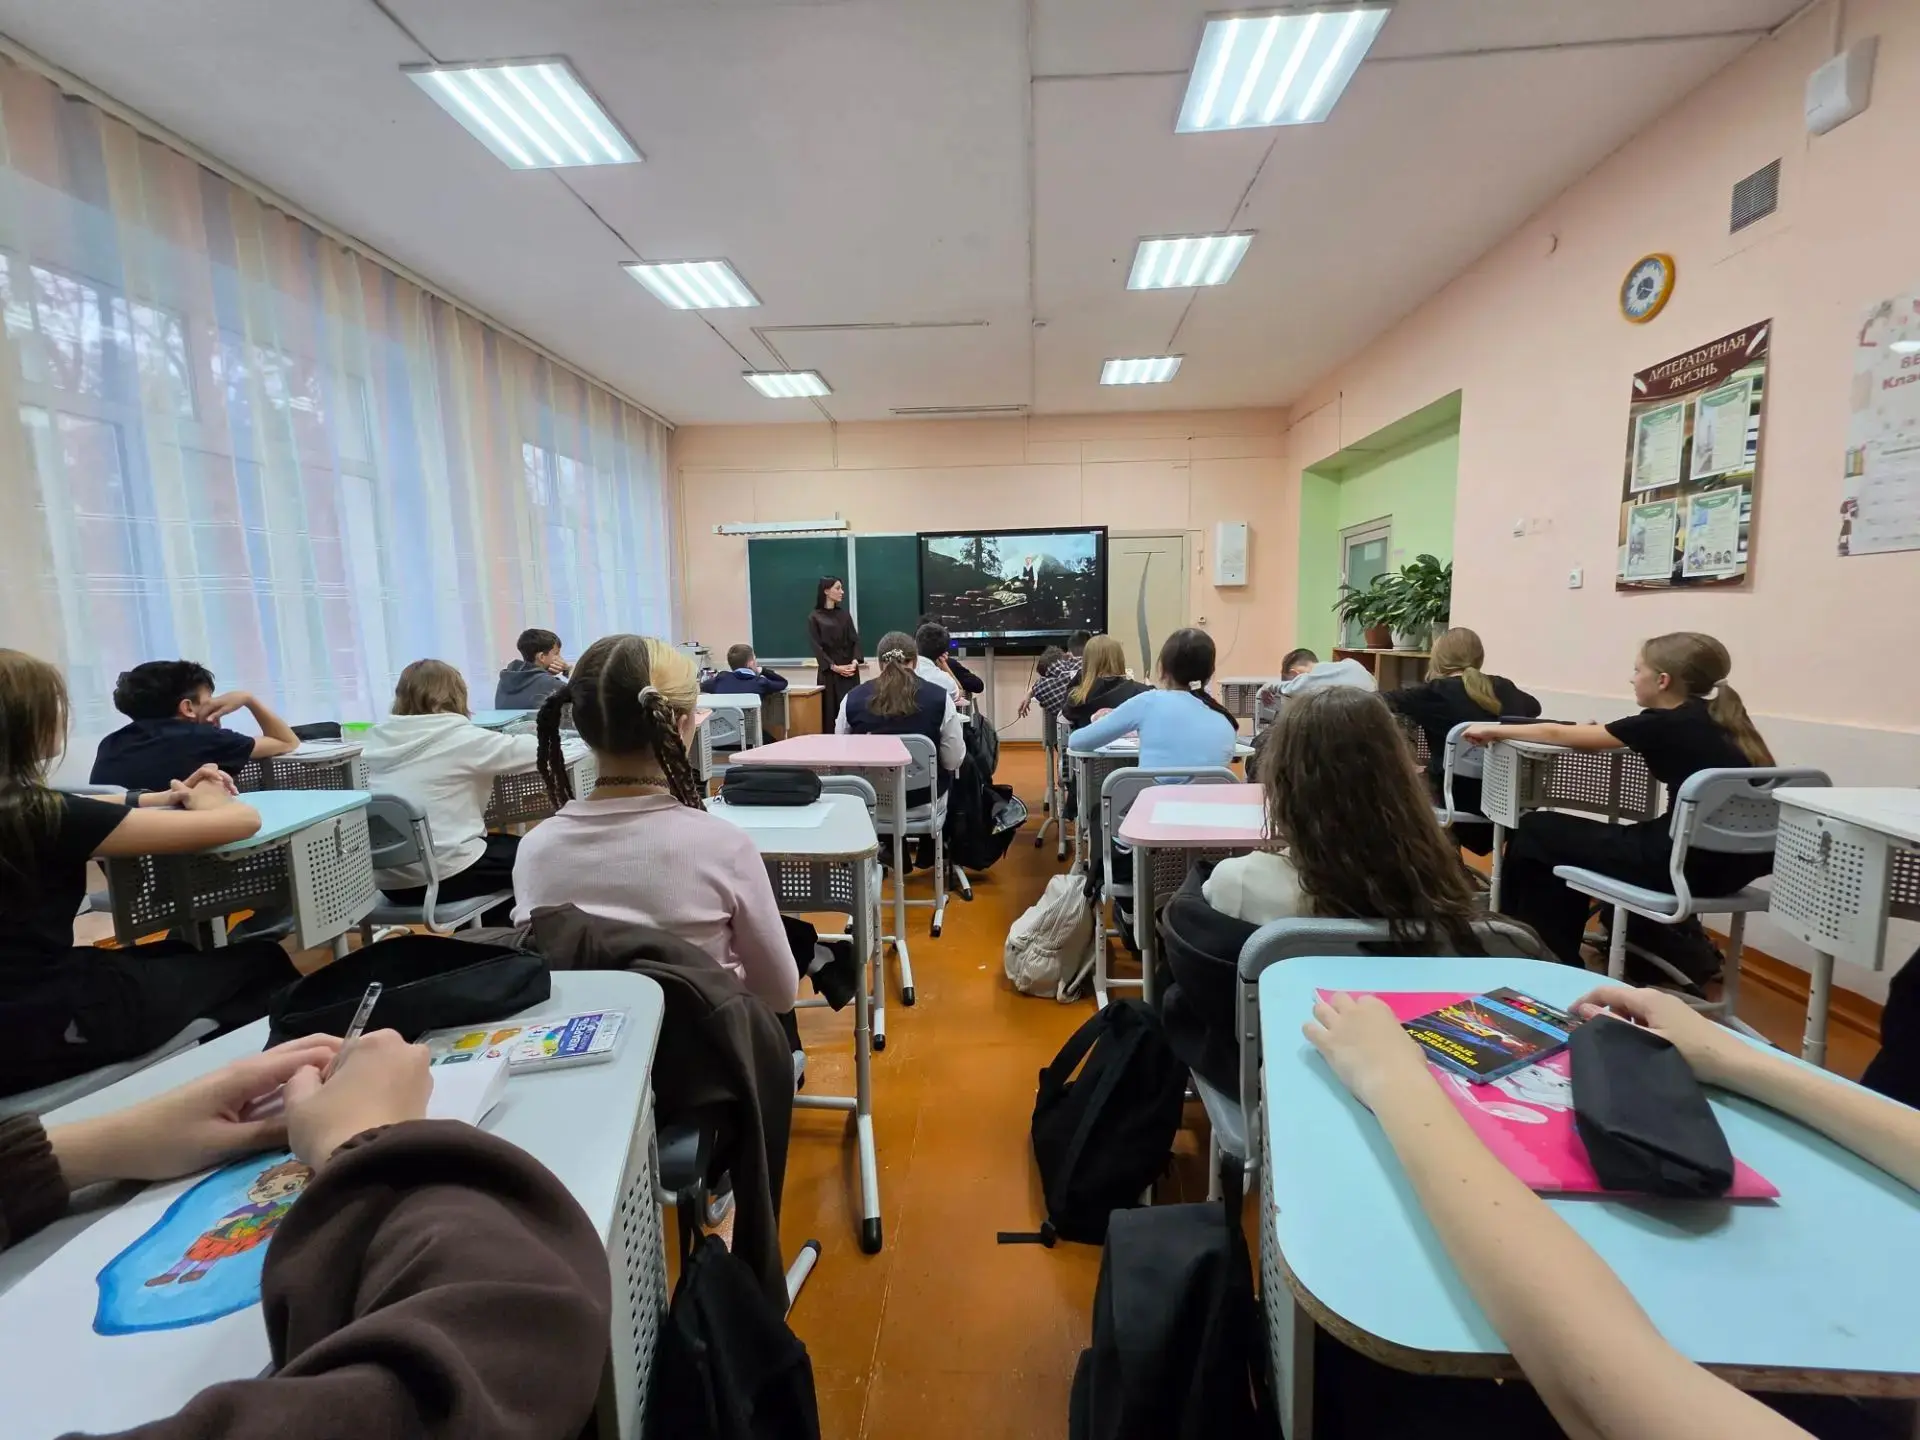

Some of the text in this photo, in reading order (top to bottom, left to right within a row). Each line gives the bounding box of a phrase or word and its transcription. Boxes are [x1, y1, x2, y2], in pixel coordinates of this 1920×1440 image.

[1649, 333, 1747, 382] ЛИТЕРАТУРНАЯ
[1669, 362, 1718, 389] ЖИЗНЬ
[1882, 373, 1920, 390] Кла
[1406, 1029, 1479, 1066] КАРАНДАШИ
[1423, 1030, 1477, 1057] ЦВЕТНЫЕ
